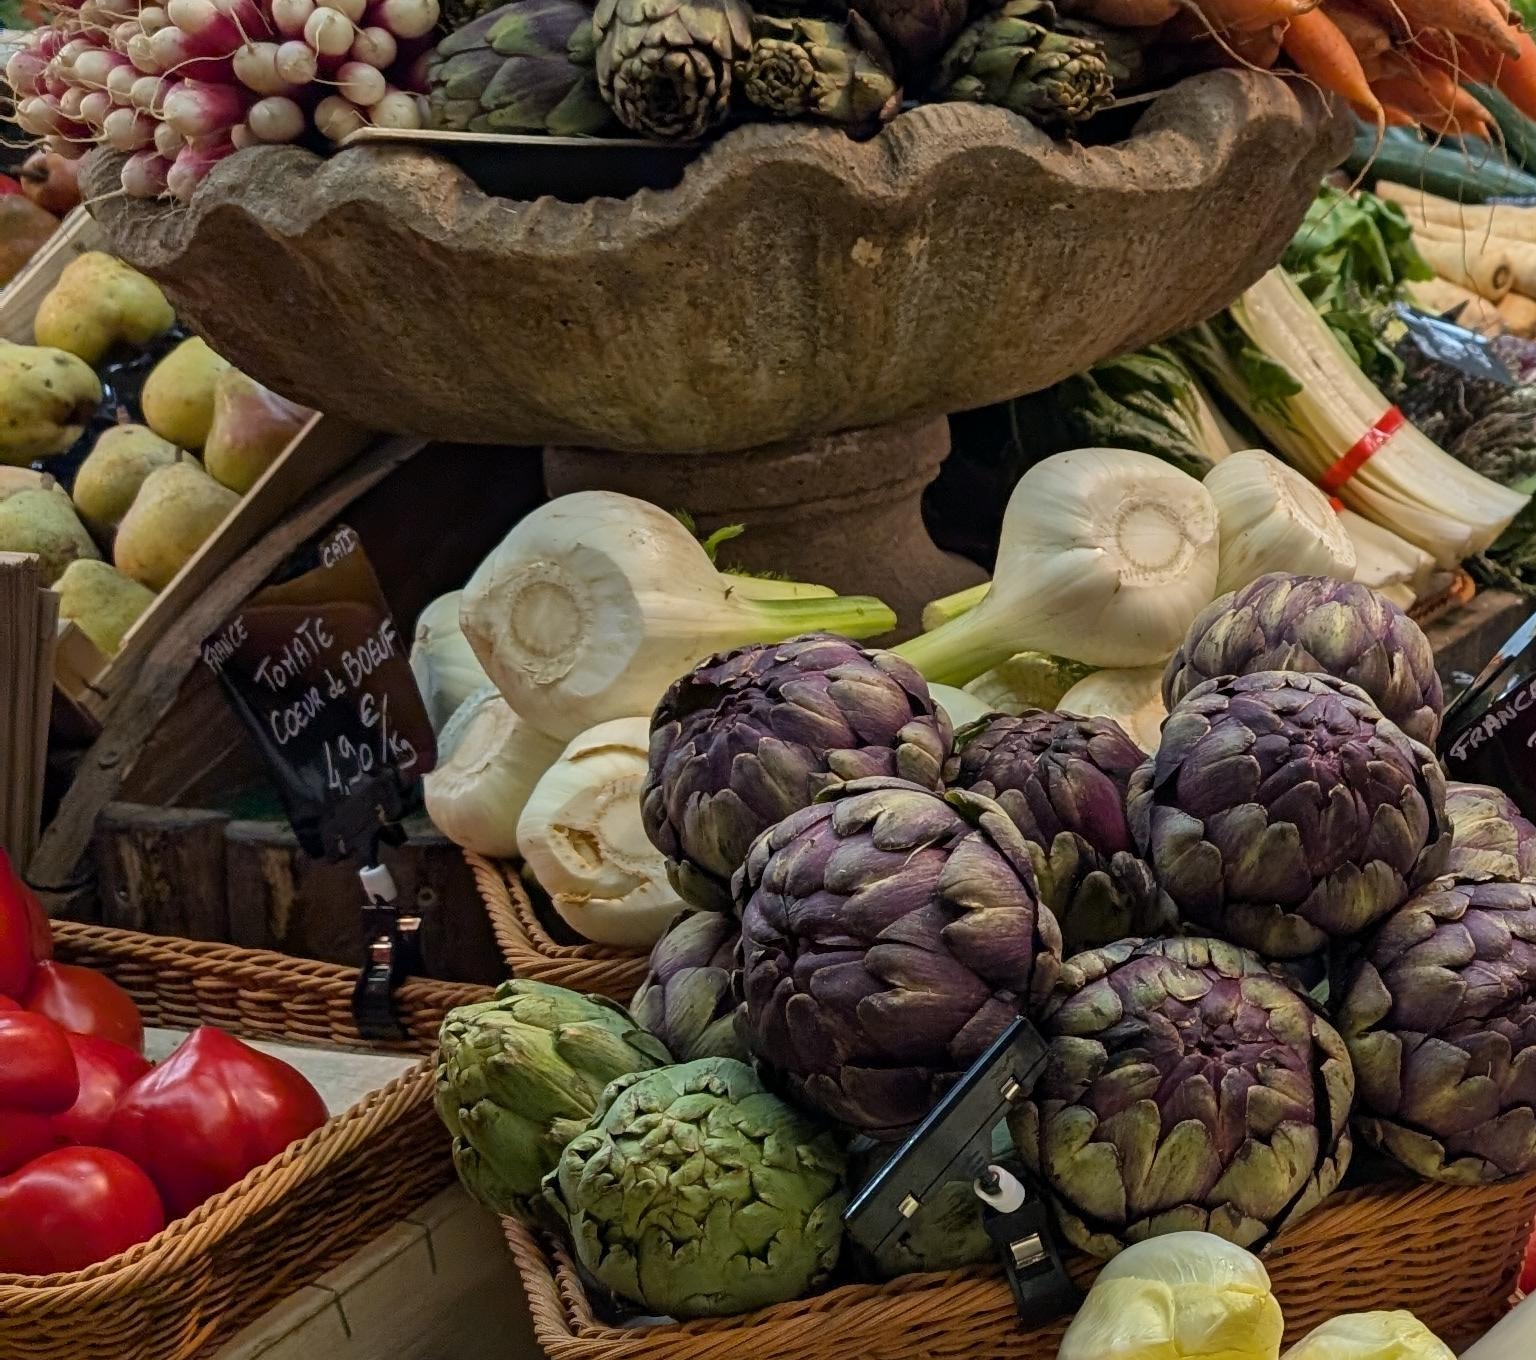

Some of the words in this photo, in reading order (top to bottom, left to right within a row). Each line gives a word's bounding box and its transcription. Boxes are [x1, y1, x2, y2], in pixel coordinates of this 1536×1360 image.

[203, 614, 249, 674] FRANCE
[254, 617, 334, 693] TOMATE
[270, 687, 326, 745] COEUR
[324, 668, 347, 700] de
[341, 615, 397, 688] BOEUF
